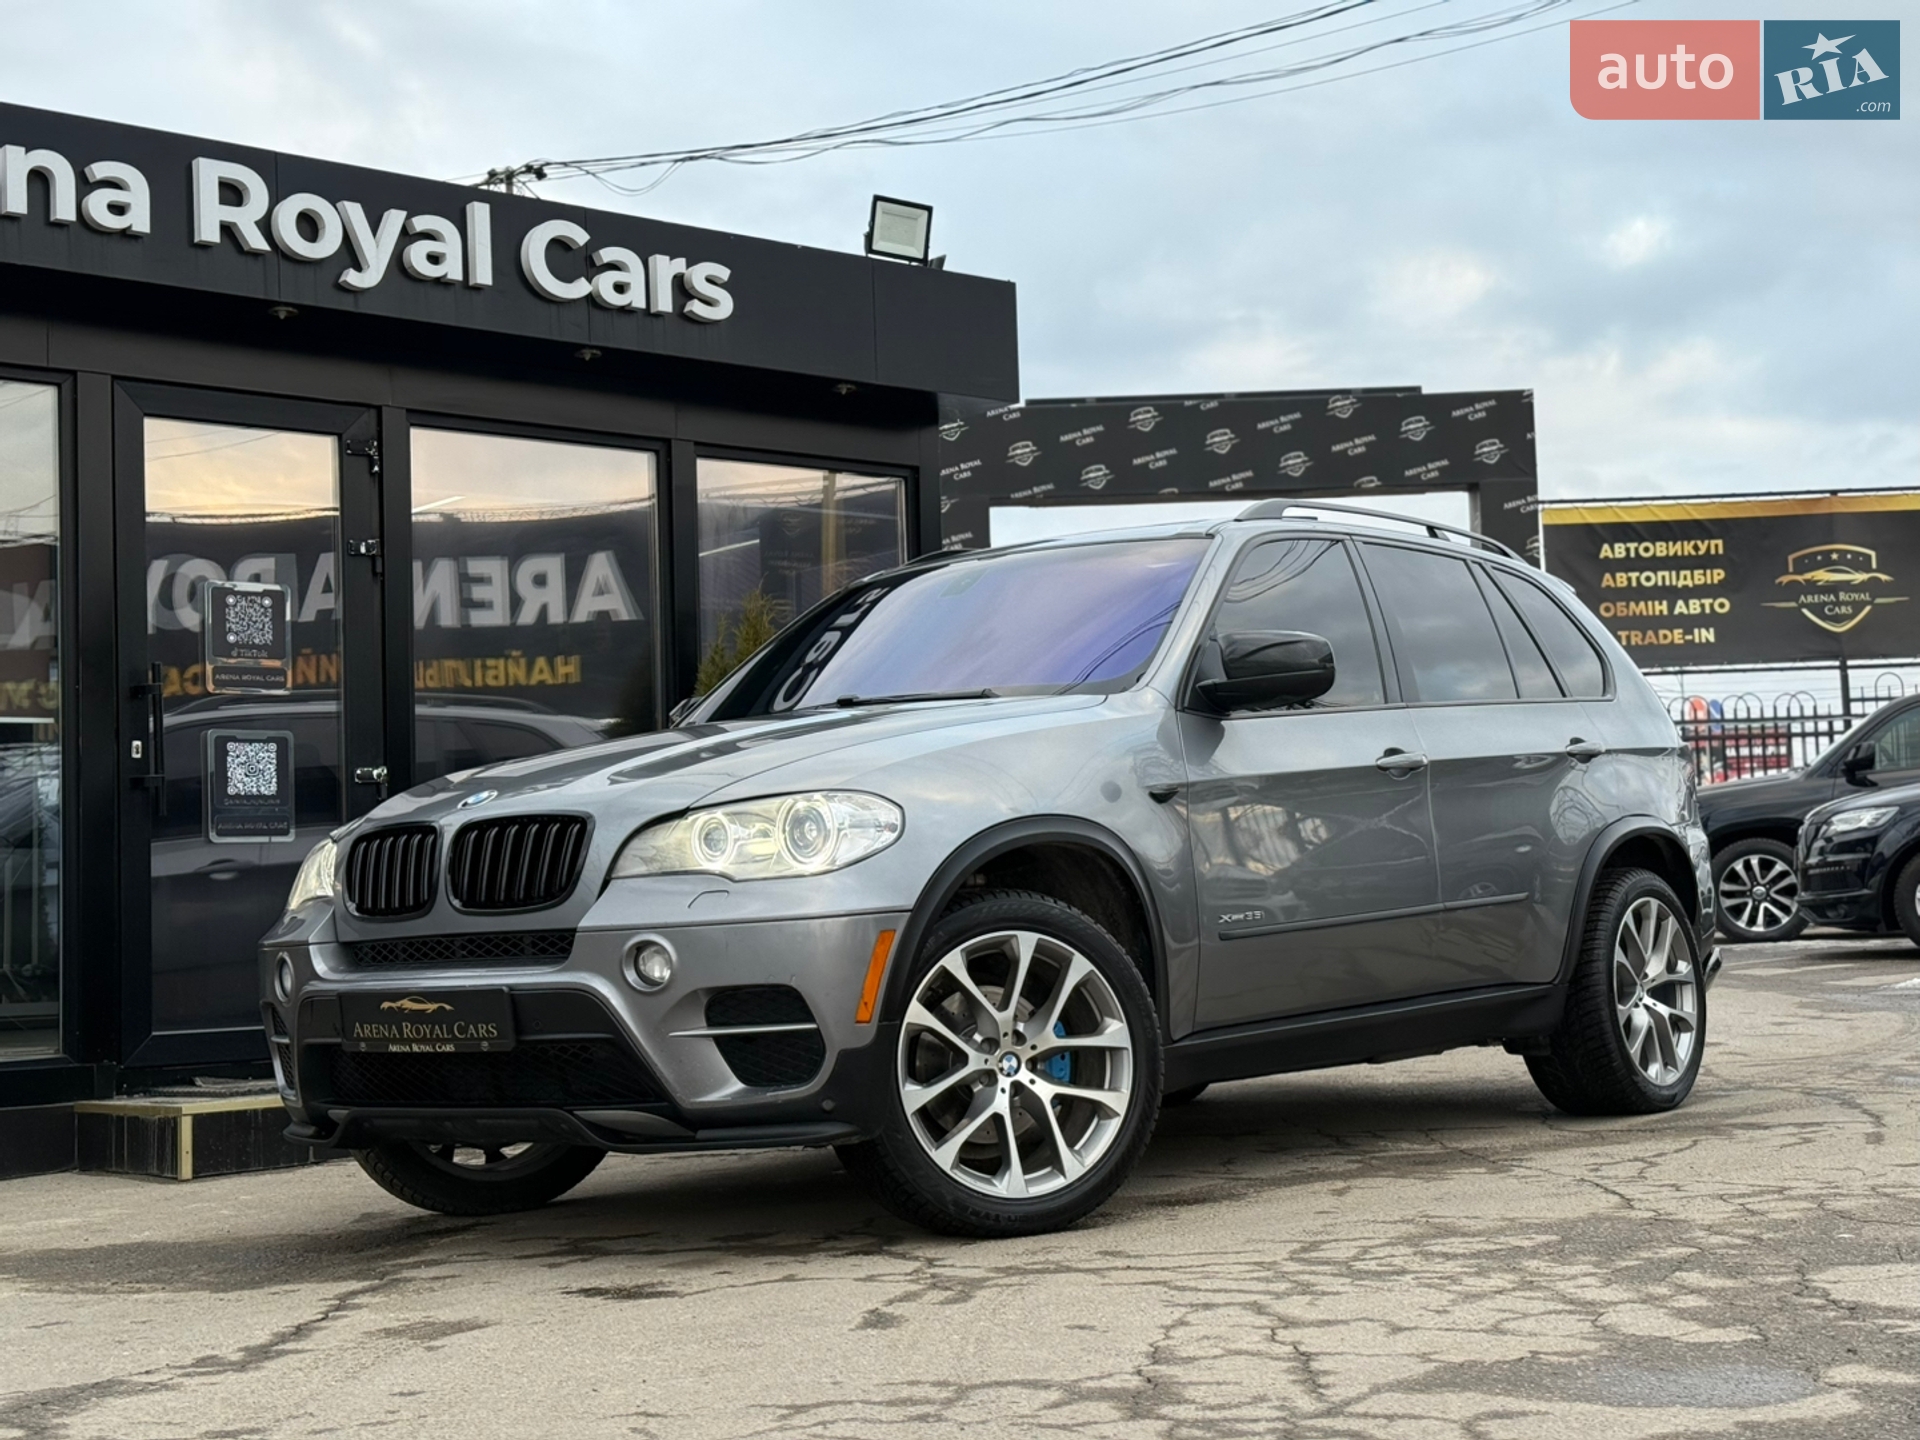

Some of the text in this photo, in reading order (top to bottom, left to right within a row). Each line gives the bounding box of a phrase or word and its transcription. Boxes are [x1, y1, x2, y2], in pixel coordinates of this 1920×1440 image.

[192, 156, 493, 291] Royal
[521, 219, 734, 322] Cars
[1599, 539, 1724, 559] АВТОВИКУП
[1601, 569, 1726, 589] АВТОПІДБІР
[1799, 591, 1871, 604] ARENA ROYAL
[1599, 597, 1731, 618] ОБМІН АВТО
[1824, 605, 1853, 615] CARS
[1617, 628, 1715, 646] TRADE-IN
[353, 1021, 498, 1039] ARENA ROYAL CARS
